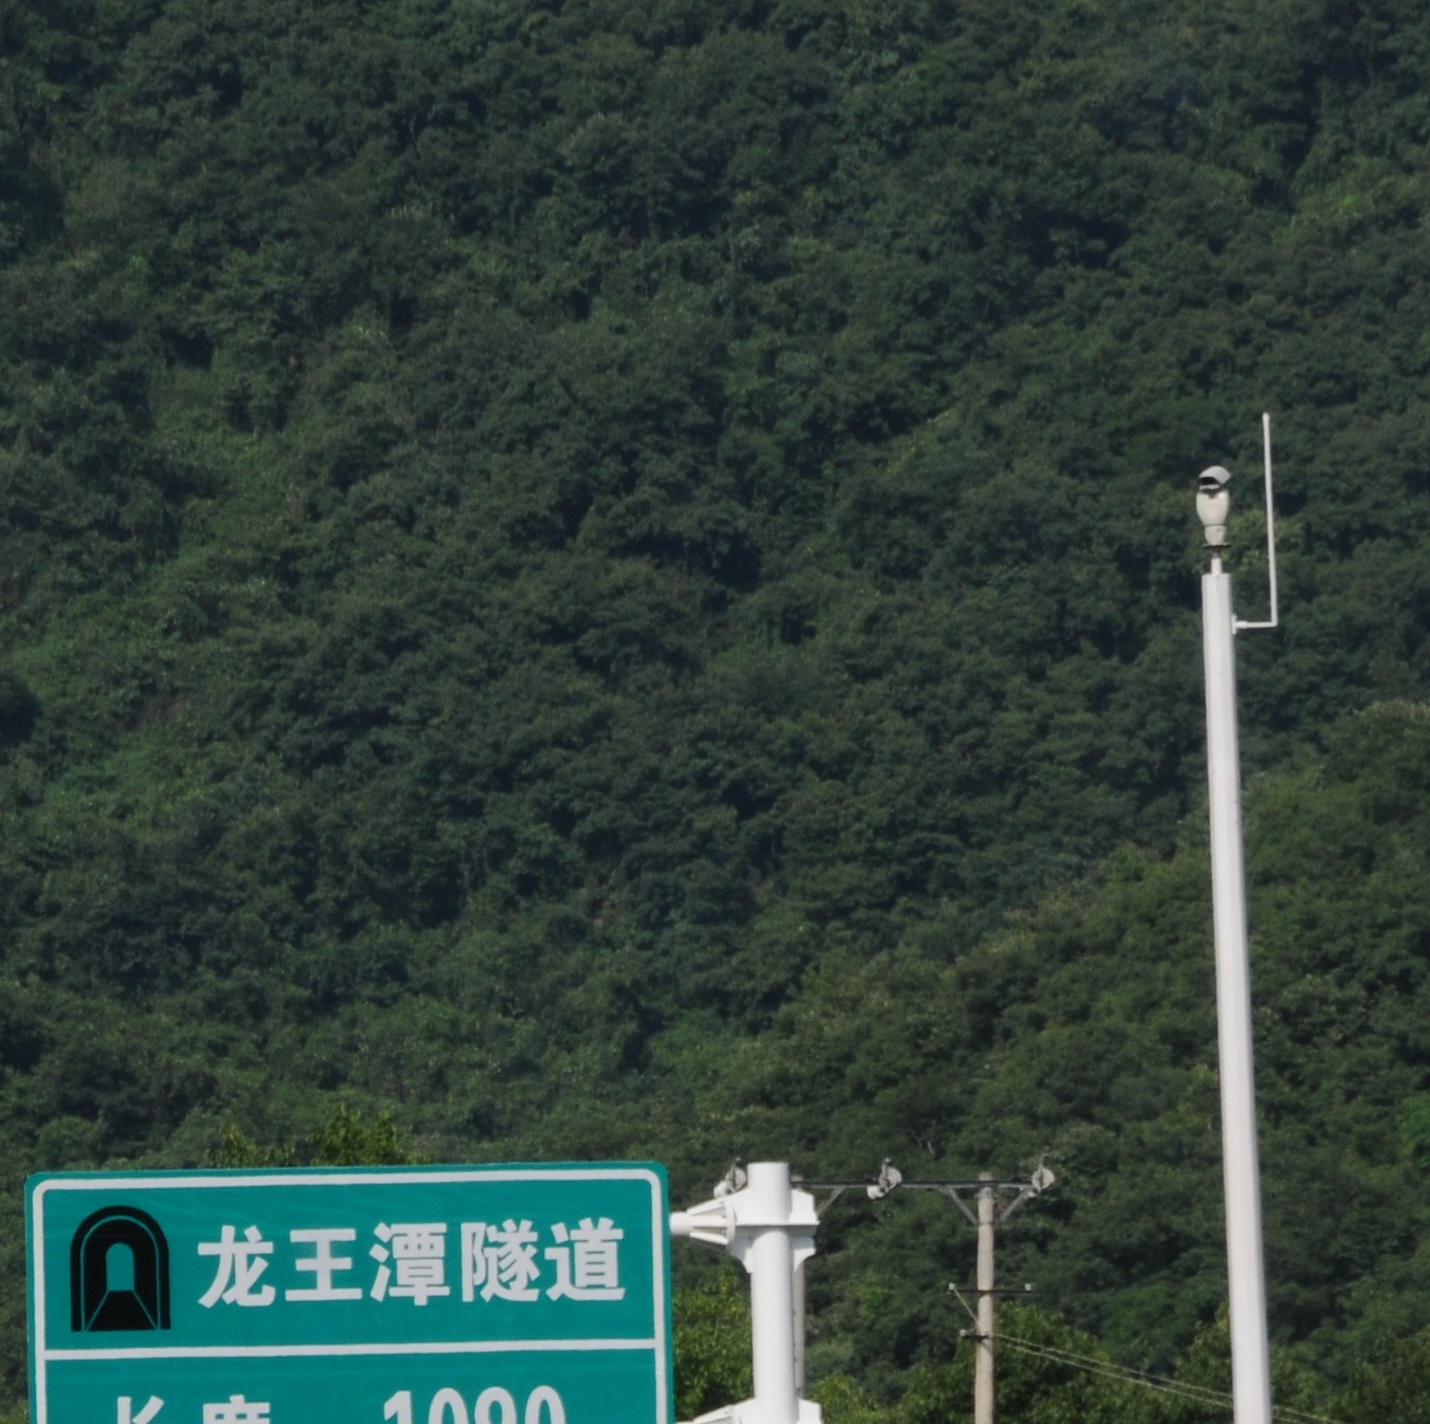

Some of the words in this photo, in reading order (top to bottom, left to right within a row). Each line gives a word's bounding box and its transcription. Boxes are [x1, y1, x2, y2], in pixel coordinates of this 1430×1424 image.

[196, 1216, 627, 1309] 龙王潭隧道
